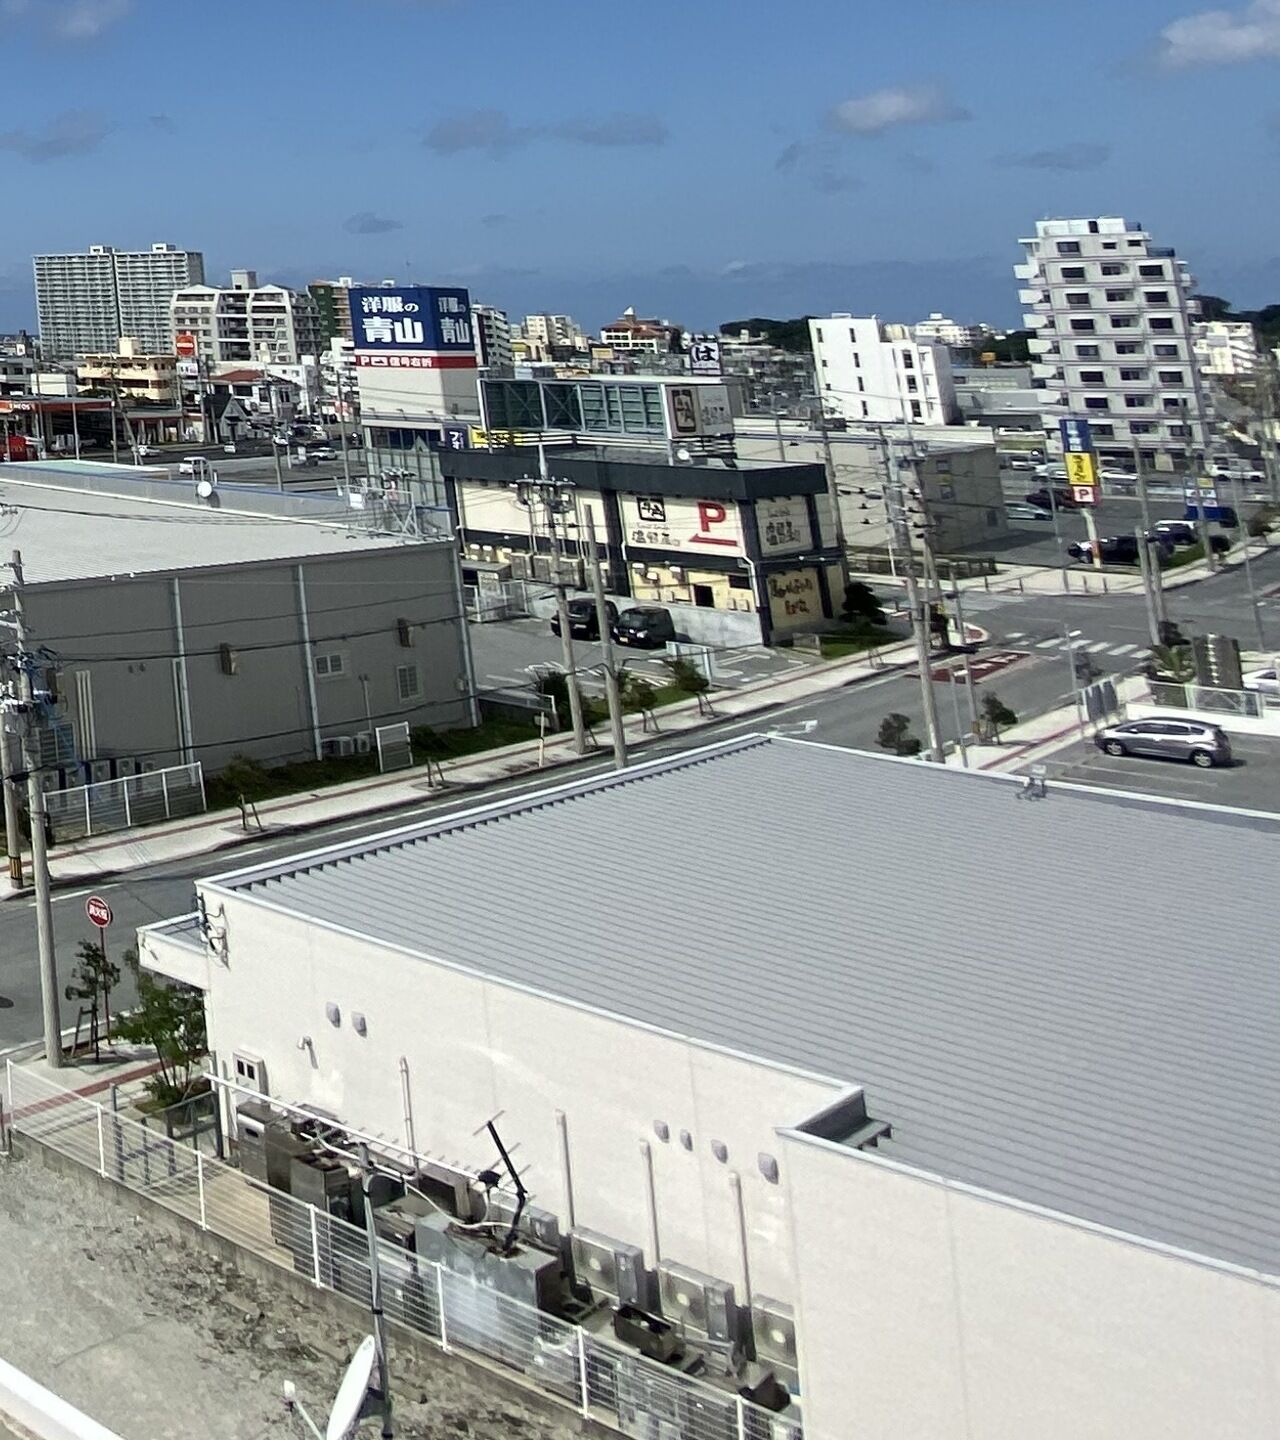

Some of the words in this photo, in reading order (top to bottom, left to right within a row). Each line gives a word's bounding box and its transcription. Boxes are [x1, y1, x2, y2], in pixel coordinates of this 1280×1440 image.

[361, 296, 419, 313] 洋服の
[362, 317, 424, 343] 青山
[440, 317, 470, 344] 青山
[360, 356, 369, 366] P
[1079, 489, 1090, 500] P
[697, 501, 726, 533] P
